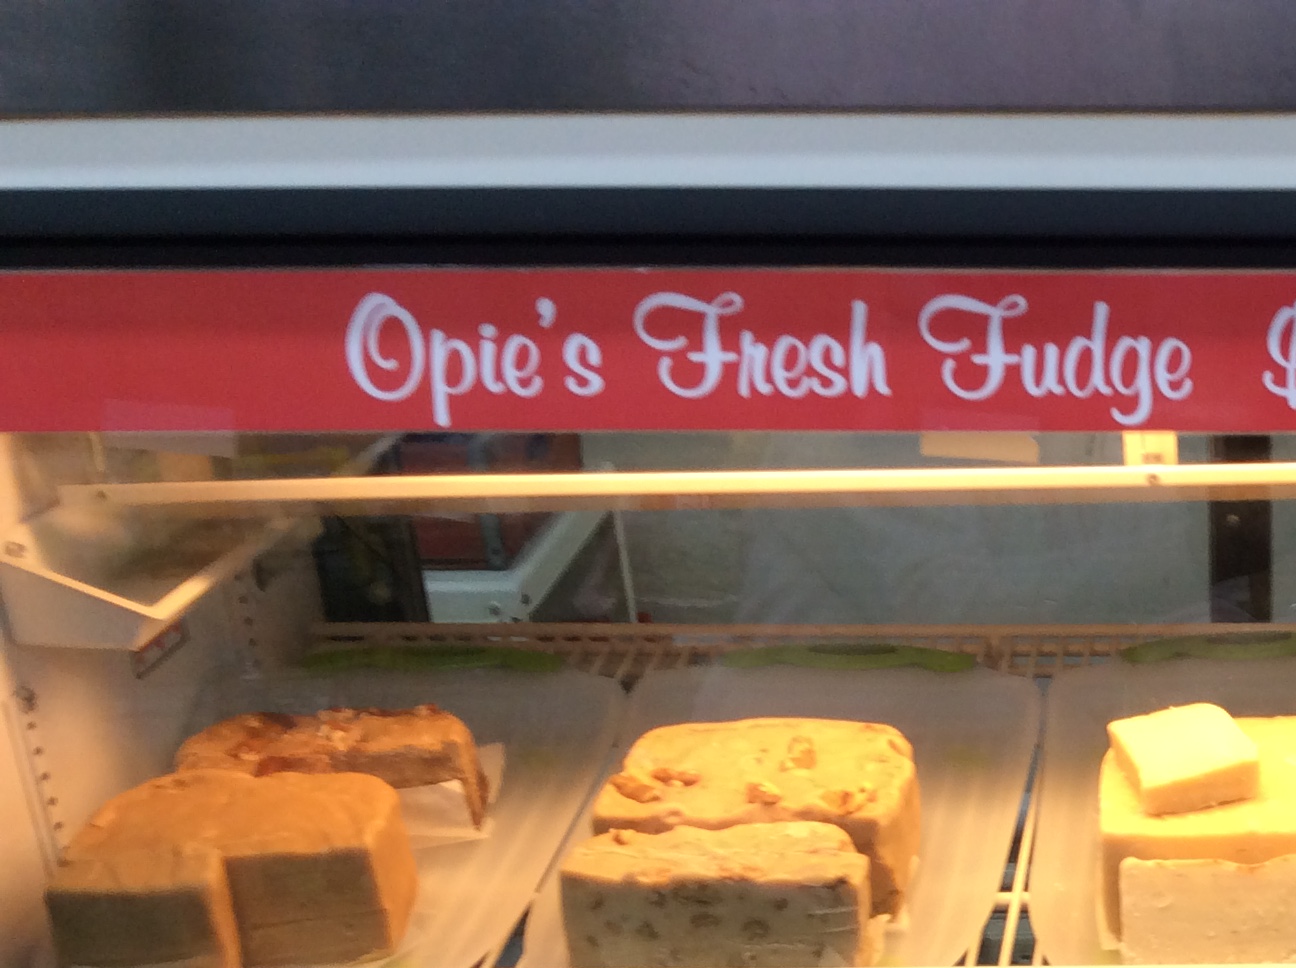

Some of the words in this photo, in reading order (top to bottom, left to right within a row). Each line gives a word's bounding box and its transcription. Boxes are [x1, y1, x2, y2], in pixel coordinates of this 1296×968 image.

[345, 291, 605, 427] Opie's
[633, 292, 893, 400] Fresh
[918, 294, 1194, 426] Fudge
